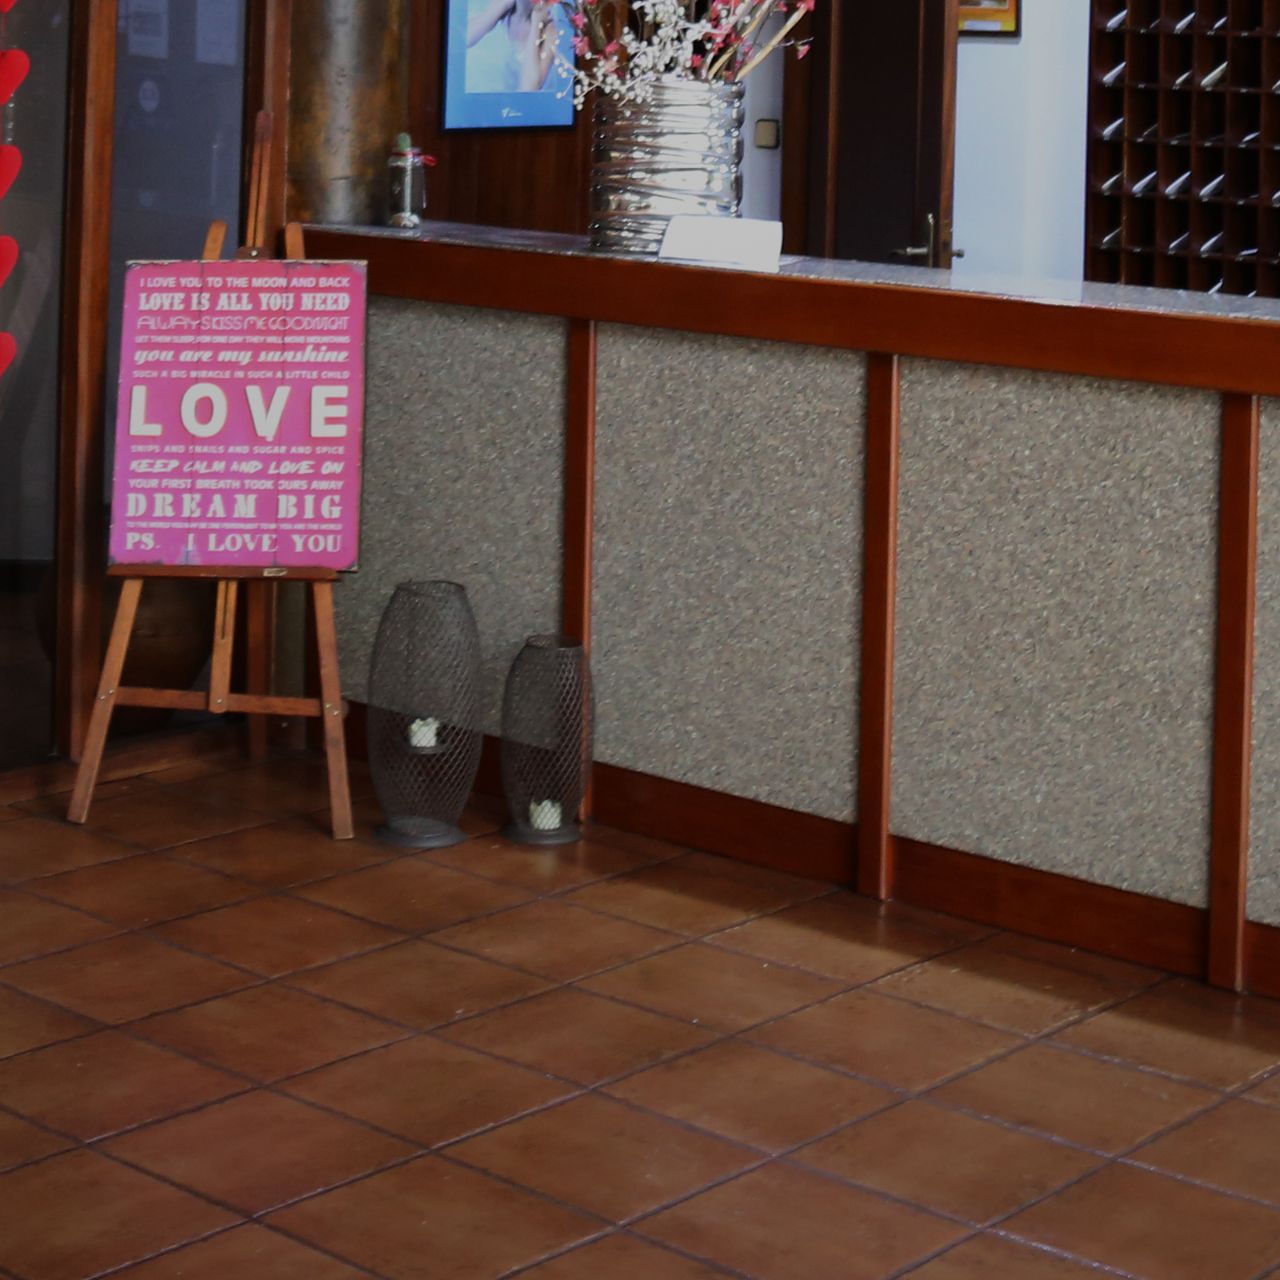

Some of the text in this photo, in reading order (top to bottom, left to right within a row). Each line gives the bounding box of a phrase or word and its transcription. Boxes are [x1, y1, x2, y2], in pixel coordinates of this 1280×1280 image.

[140, 277, 351, 288] I LOVE YOU TO THE MOON AND BACK
[138, 293, 351, 312] LOVE IS ALL YOU NEED
[137, 316, 210, 331] ALWAYS
[269, 315, 351, 331] GOODNIGHT
[134, 344, 349, 366] you are my sunshine
[285, 371, 317, 380] LITTLE
[129, 383, 349, 442] LOVE
[163, 445, 185, 454] AND
[228, 446, 249, 455] AND
[290, 446, 311, 455] AND
[315, 446, 345, 455] SPICE
[129, 459, 345, 475] KEEP CALM AND LOVE ON
[128, 479, 159, 489] YOUR
[161, 479, 193, 489] FIRST
[196, 479, 241, 490] BREATH
[244, 480, 274, 490] TOOK
[310, 480, 345, 490] AWAY
[125, 492, 343, 519] DREAM BIG
[125, 532, 343, 553] PS. I LOVE YOU
